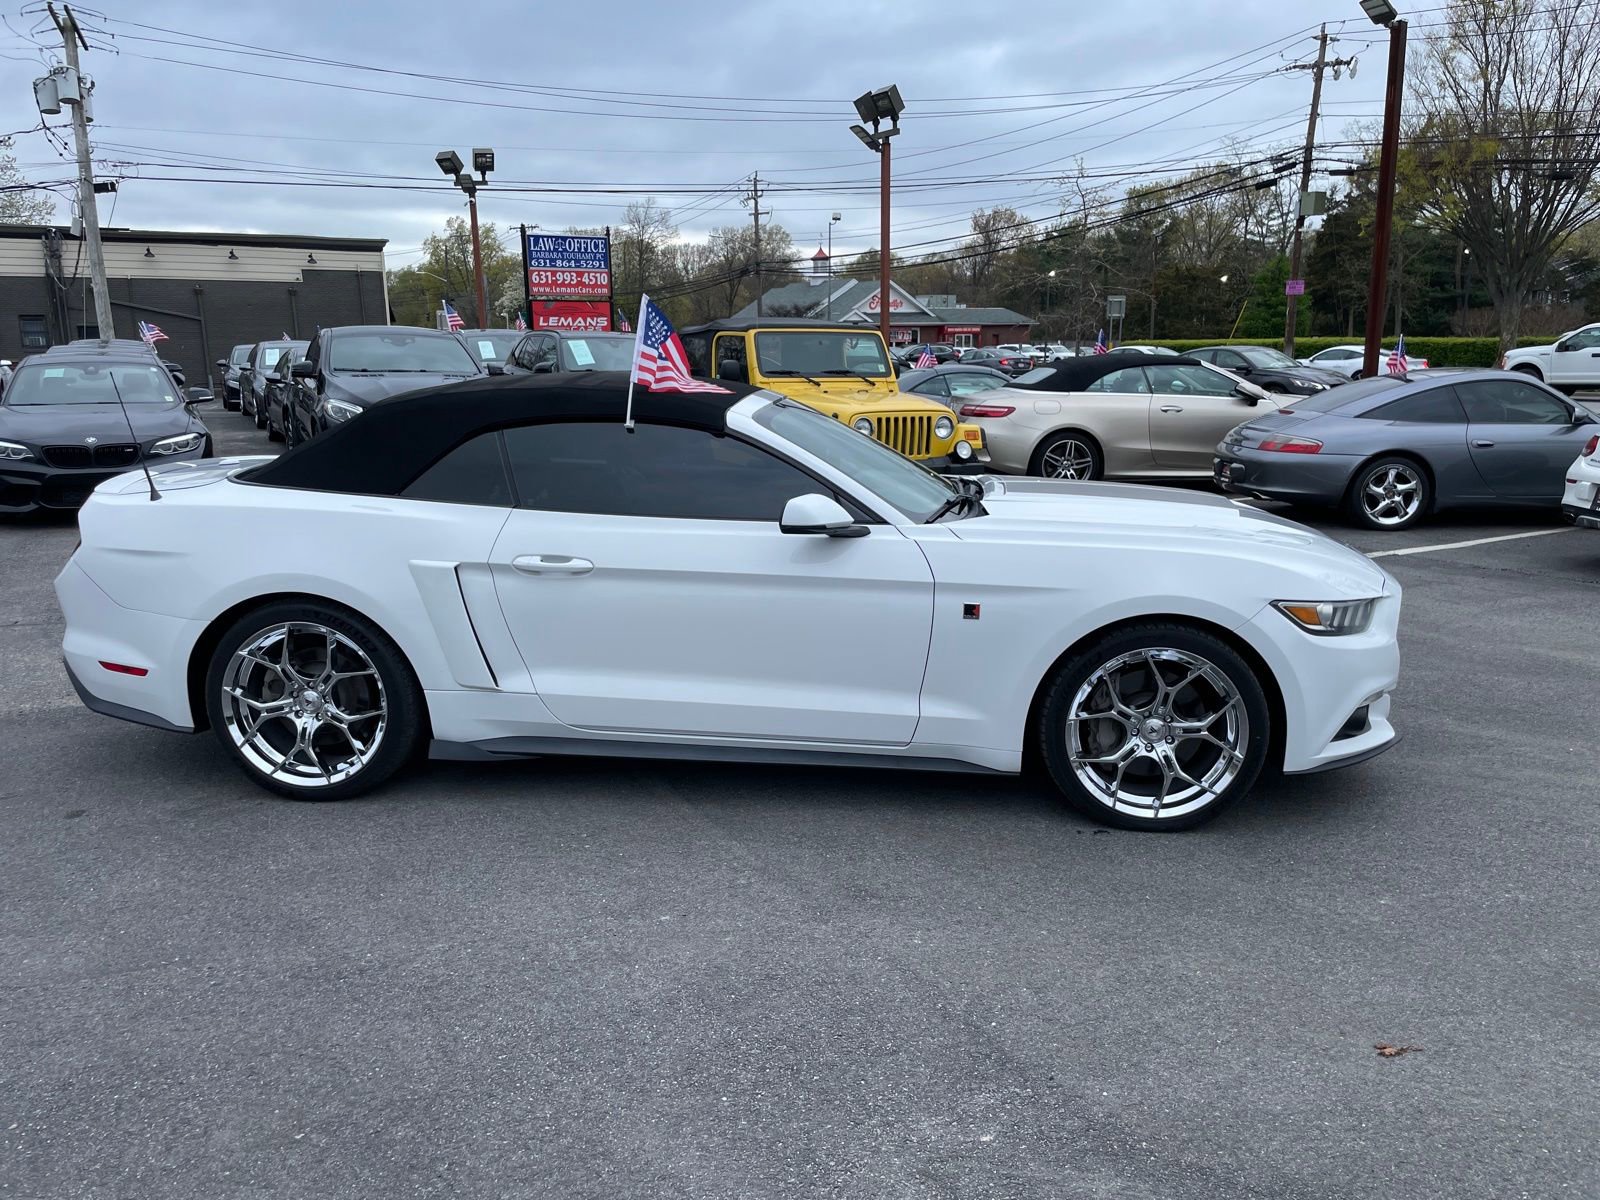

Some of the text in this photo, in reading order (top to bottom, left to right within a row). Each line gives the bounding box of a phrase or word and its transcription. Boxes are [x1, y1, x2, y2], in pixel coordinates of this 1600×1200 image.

[529, 236, 606, 253] LAW OFFICE
[532, 251, 562, 259] BARBARA
[562, 252, 595, 260] TOUHAMY
[531, 259, 606, 269] 631-864-5291
[532, 271, 608, 285] 631-993-4510
[532, 285, 608, 294] www.LemansCars.com
[539, 316, 608, 326] LEMANS
